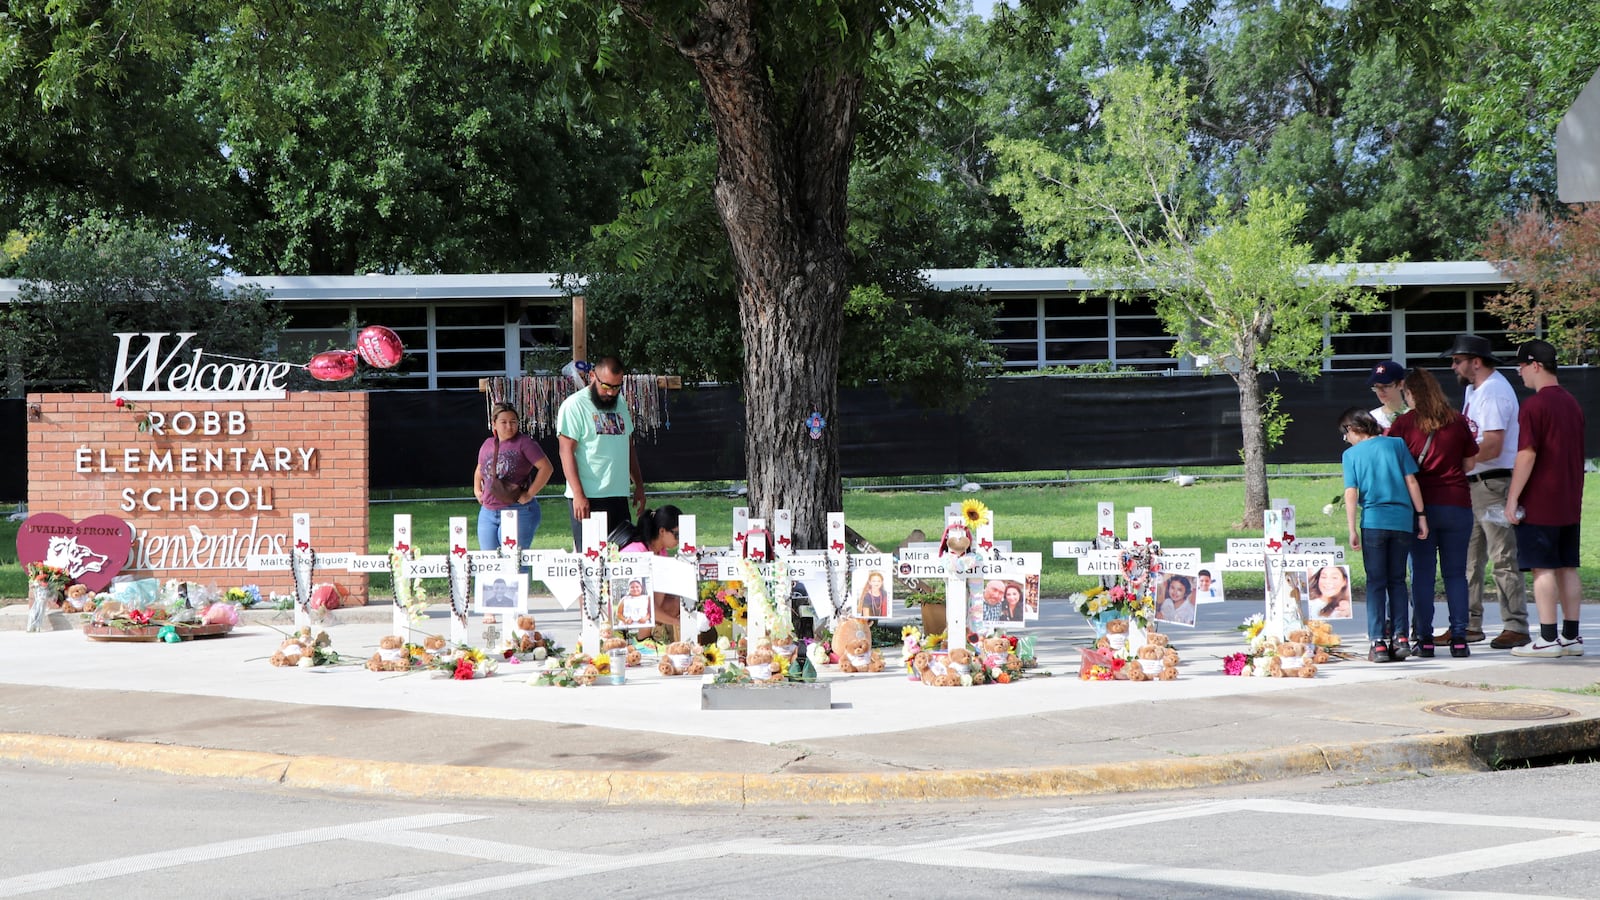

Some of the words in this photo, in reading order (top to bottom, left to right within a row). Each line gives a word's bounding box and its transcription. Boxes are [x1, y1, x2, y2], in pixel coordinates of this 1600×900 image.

[111, 332, 291, 392] Welcome
[149, 410, 247, 436] ROBB
[76, 447, 315, 473] ELEMENTARY
[120, 486, 273, 512] SCHOOL
[547, 566, 578, 577] Ellie
[585, 565, 633, 577] Garcia
[913, 564, 946, 574] Irma
[1087, 561, 1120, 571] Alithi
[1225, 558, 1265, 568] Jackie
[1271, 558, 1329, 568] Cazares
